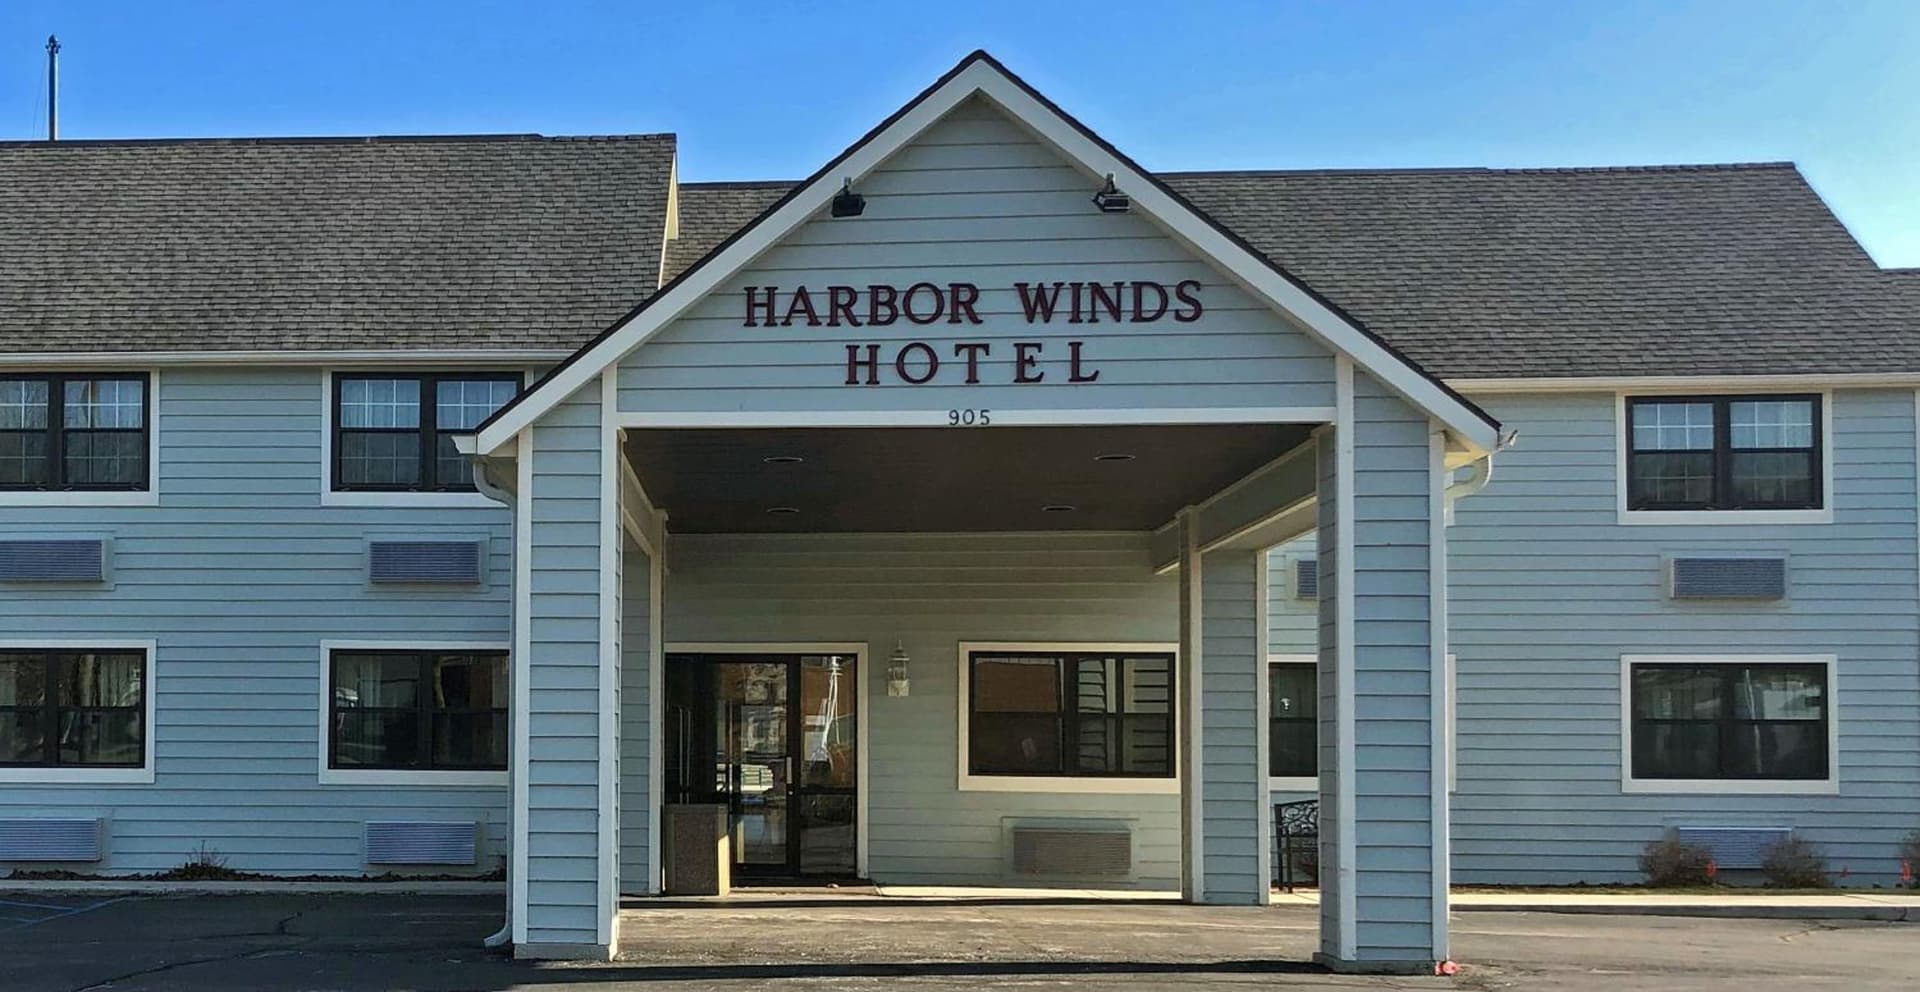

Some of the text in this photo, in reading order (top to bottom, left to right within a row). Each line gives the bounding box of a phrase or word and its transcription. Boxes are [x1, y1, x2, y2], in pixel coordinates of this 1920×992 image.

[743, 280, 1203, 327] HARBOR WINDS
[844, 341, 1100, 385] HOTEL
[948, 408, 991, 426] 905
